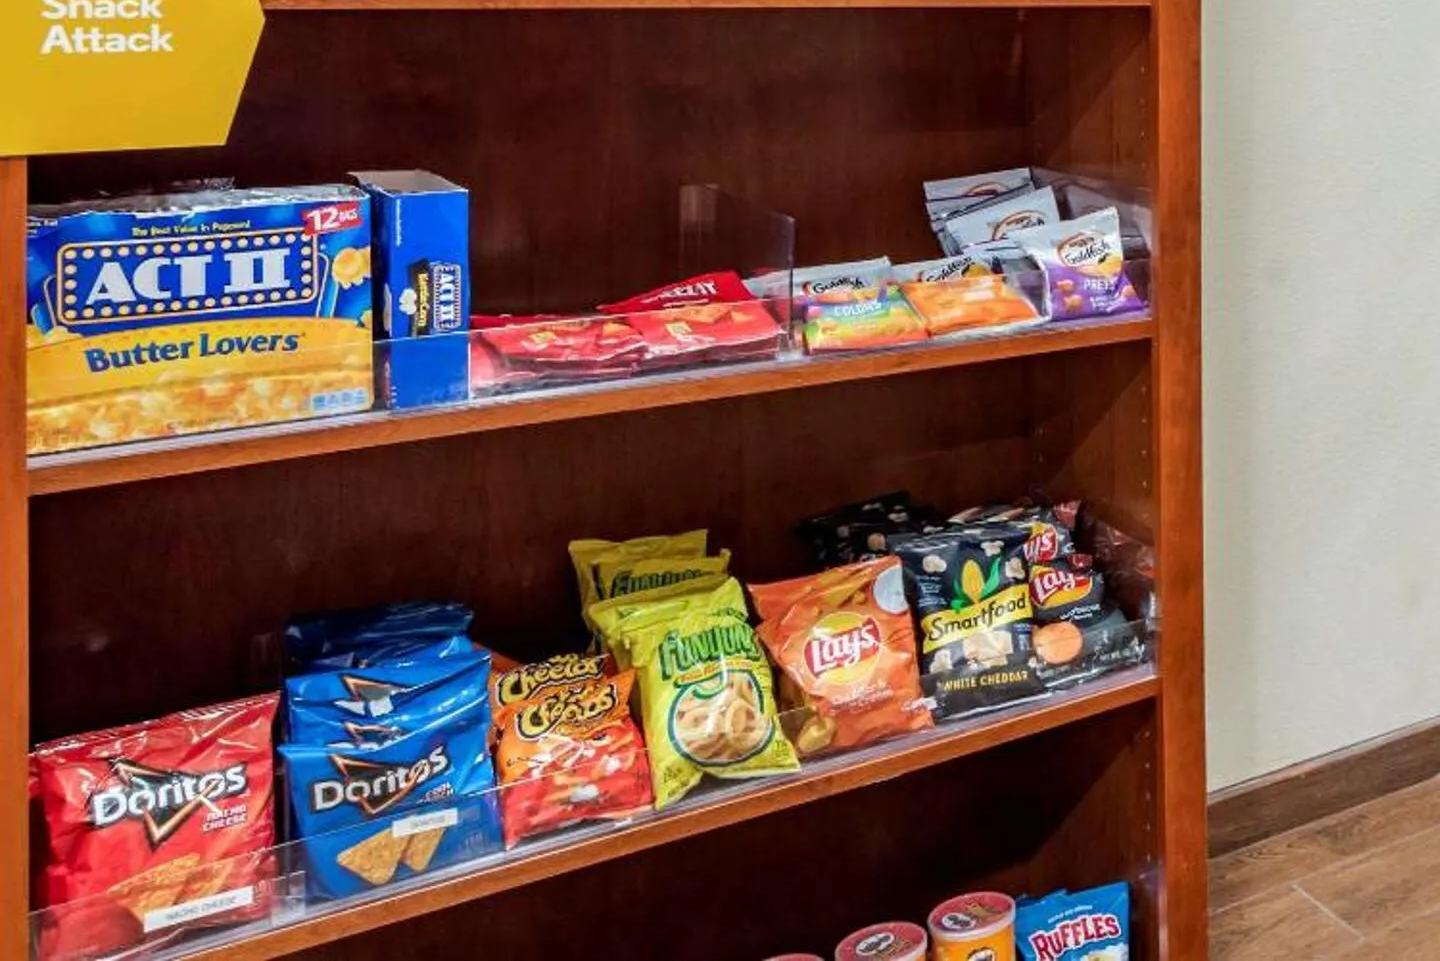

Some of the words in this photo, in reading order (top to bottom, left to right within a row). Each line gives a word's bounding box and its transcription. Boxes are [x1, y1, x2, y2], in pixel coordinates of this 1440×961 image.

[40, 24, 174, 54] Attack
[305, 208, 340, 230] 12
[86, 255, 213, 305] ACT
[223, 248, 291, 293] II
[440, 273, 455, 302] ACT
[83, 340, 194, 373] Butter
[200, 332, 300, 357] Lovers
[930, 595, 1026, 640] Smartfood
[93, 765, 246, 826] Doritos
[314, 745, 449, 812] Doritos
[1033, 915, 1121, 961] RUFFLES
